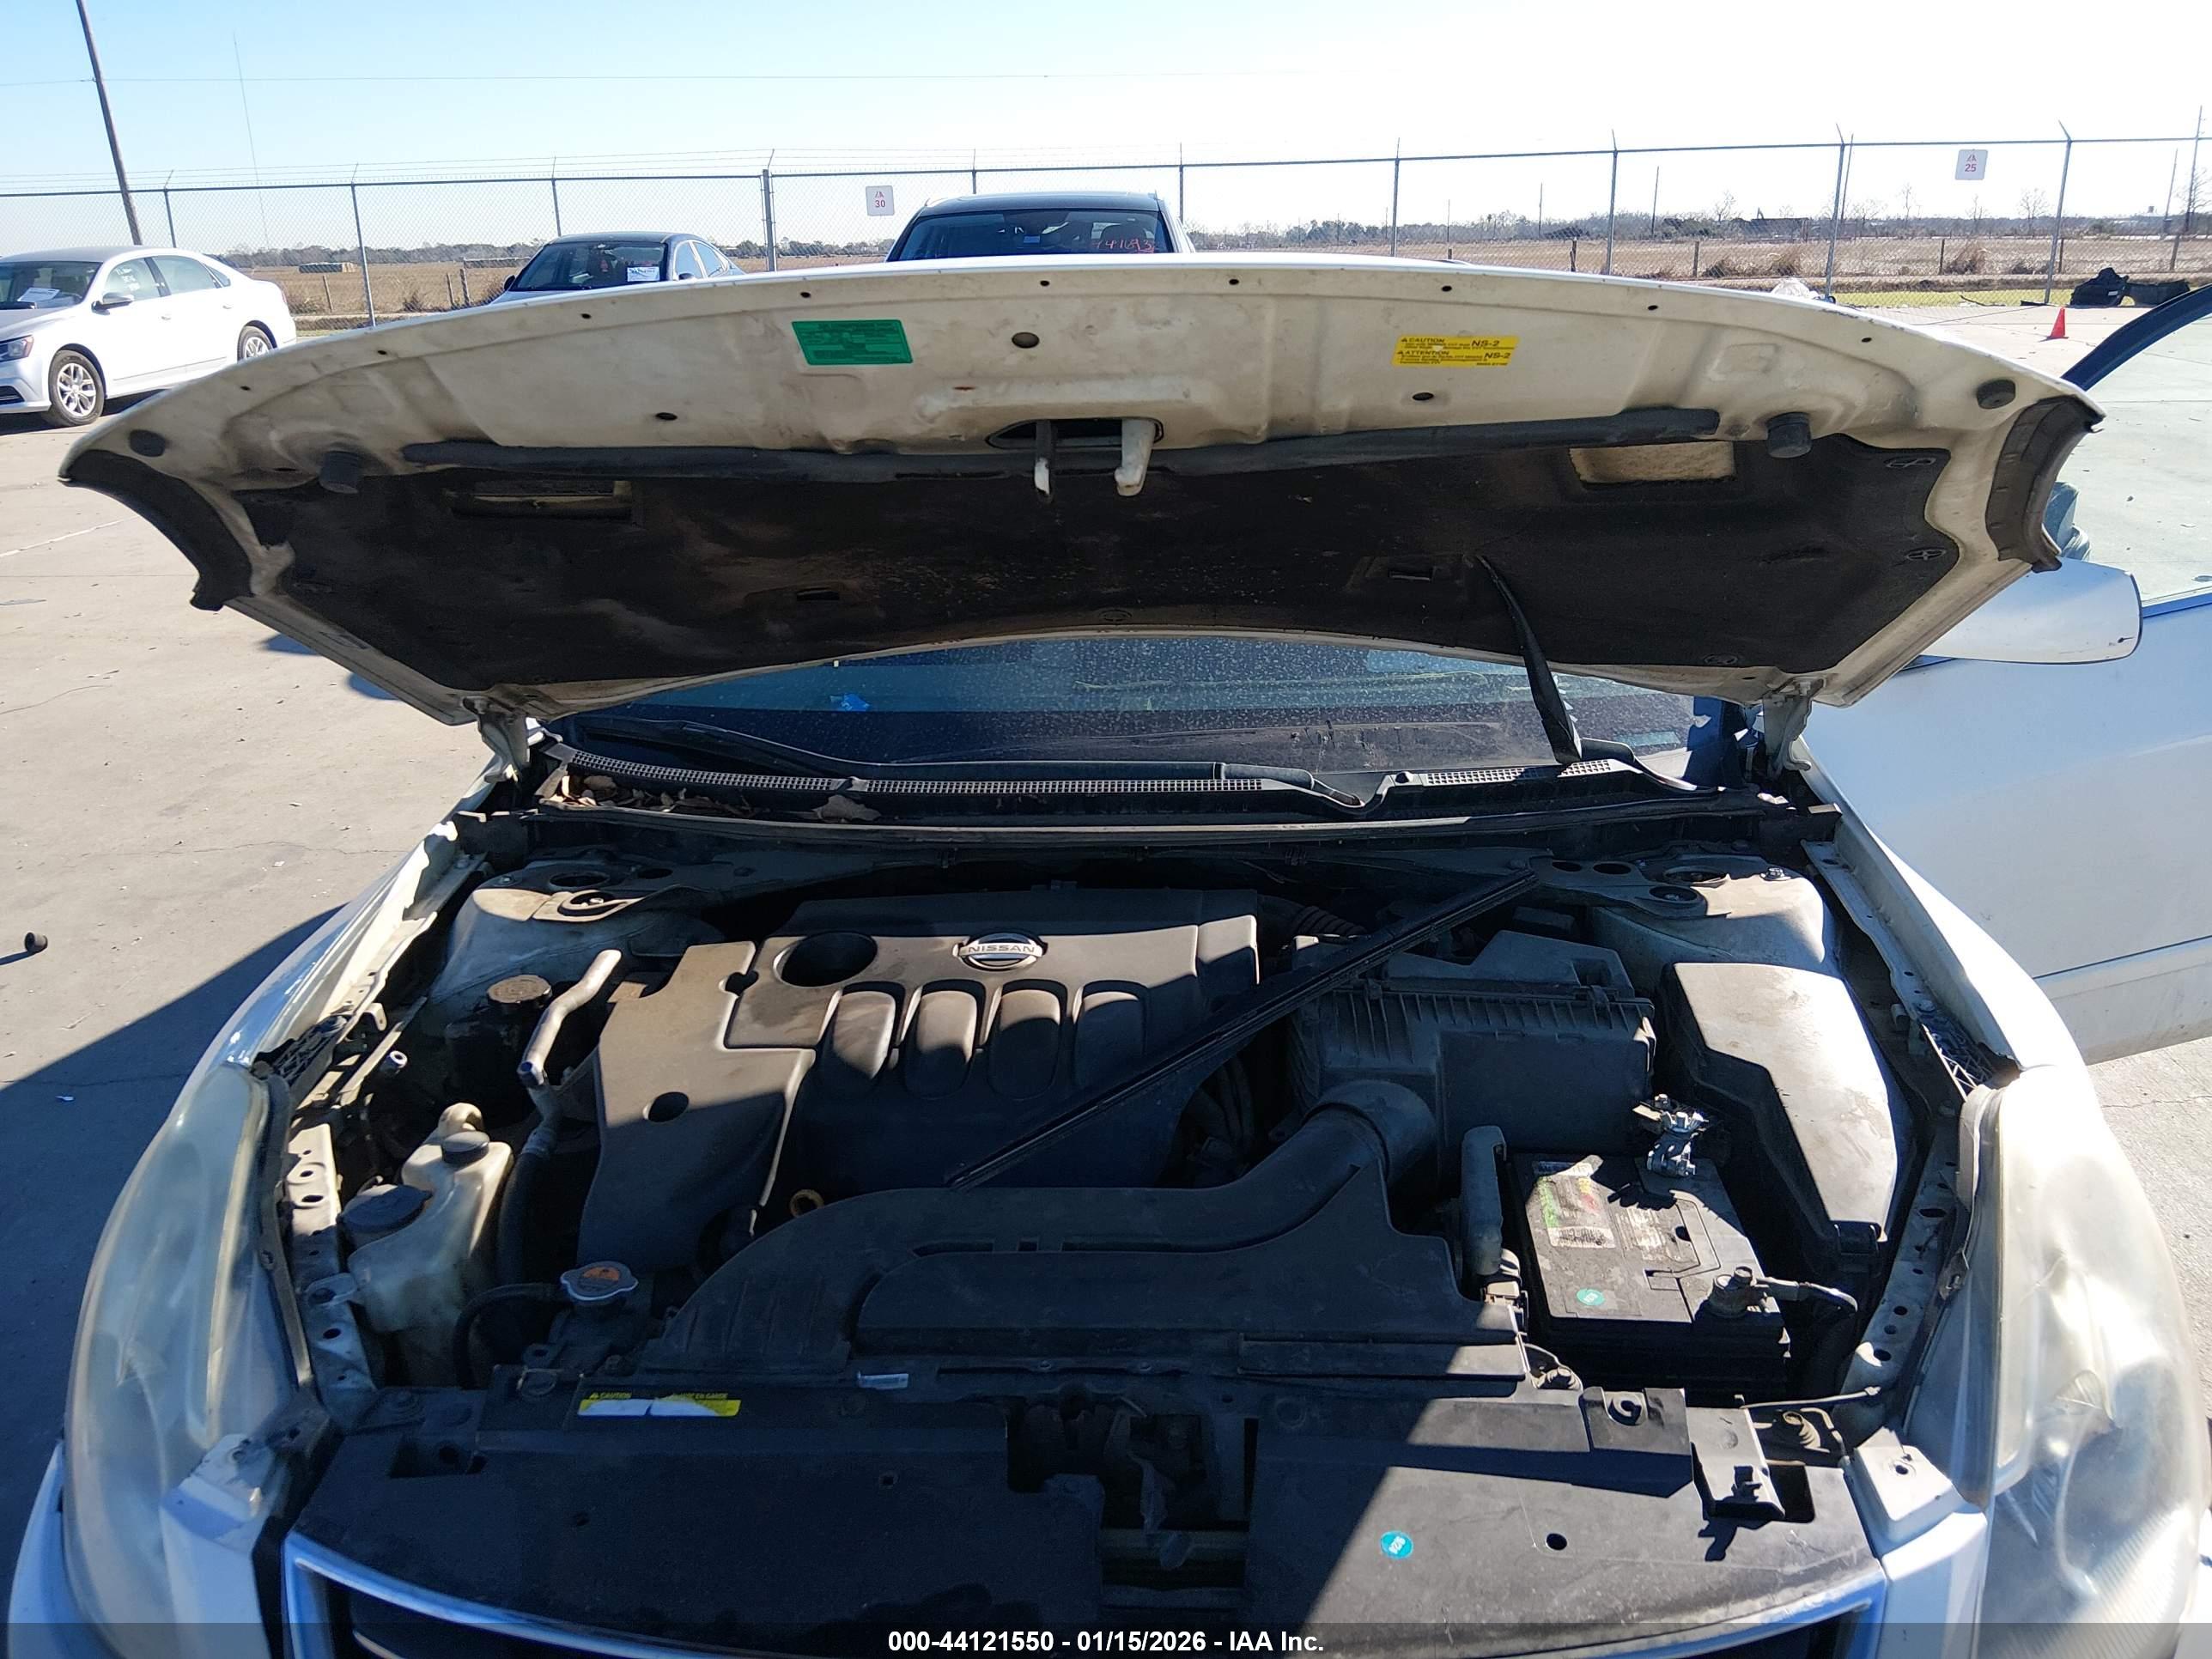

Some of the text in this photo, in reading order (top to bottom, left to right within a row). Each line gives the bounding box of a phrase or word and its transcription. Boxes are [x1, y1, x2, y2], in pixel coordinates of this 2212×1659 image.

[1965, 163, 1977, 172] 25
[875, 199, 885, 208] 30
[968, 945, 1035, 953] NISSAN
